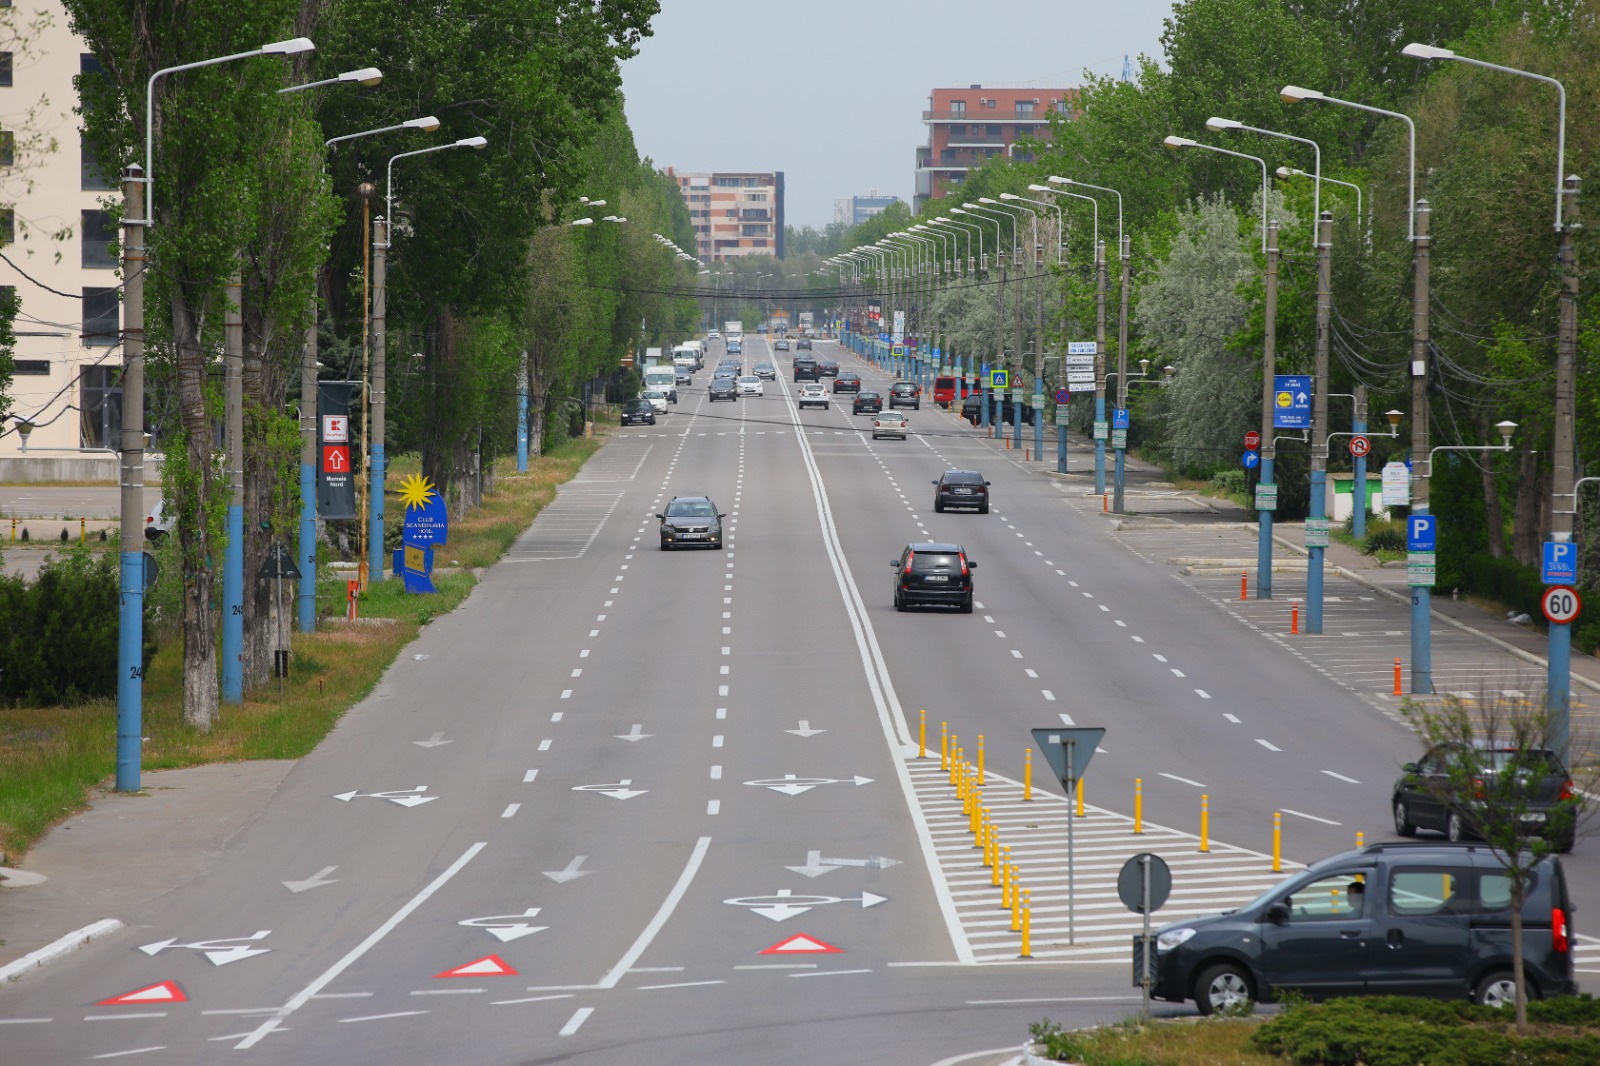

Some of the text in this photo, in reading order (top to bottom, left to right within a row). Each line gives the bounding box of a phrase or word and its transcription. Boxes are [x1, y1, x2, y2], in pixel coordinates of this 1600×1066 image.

[1117, 410, 1125, 419] P
[1245, 437, 1259, 445] STOP
[1414, 519, 1429, 539] P
[1553, 544, 1568, 562] P
[1550, 594, 1572, 614] 60
